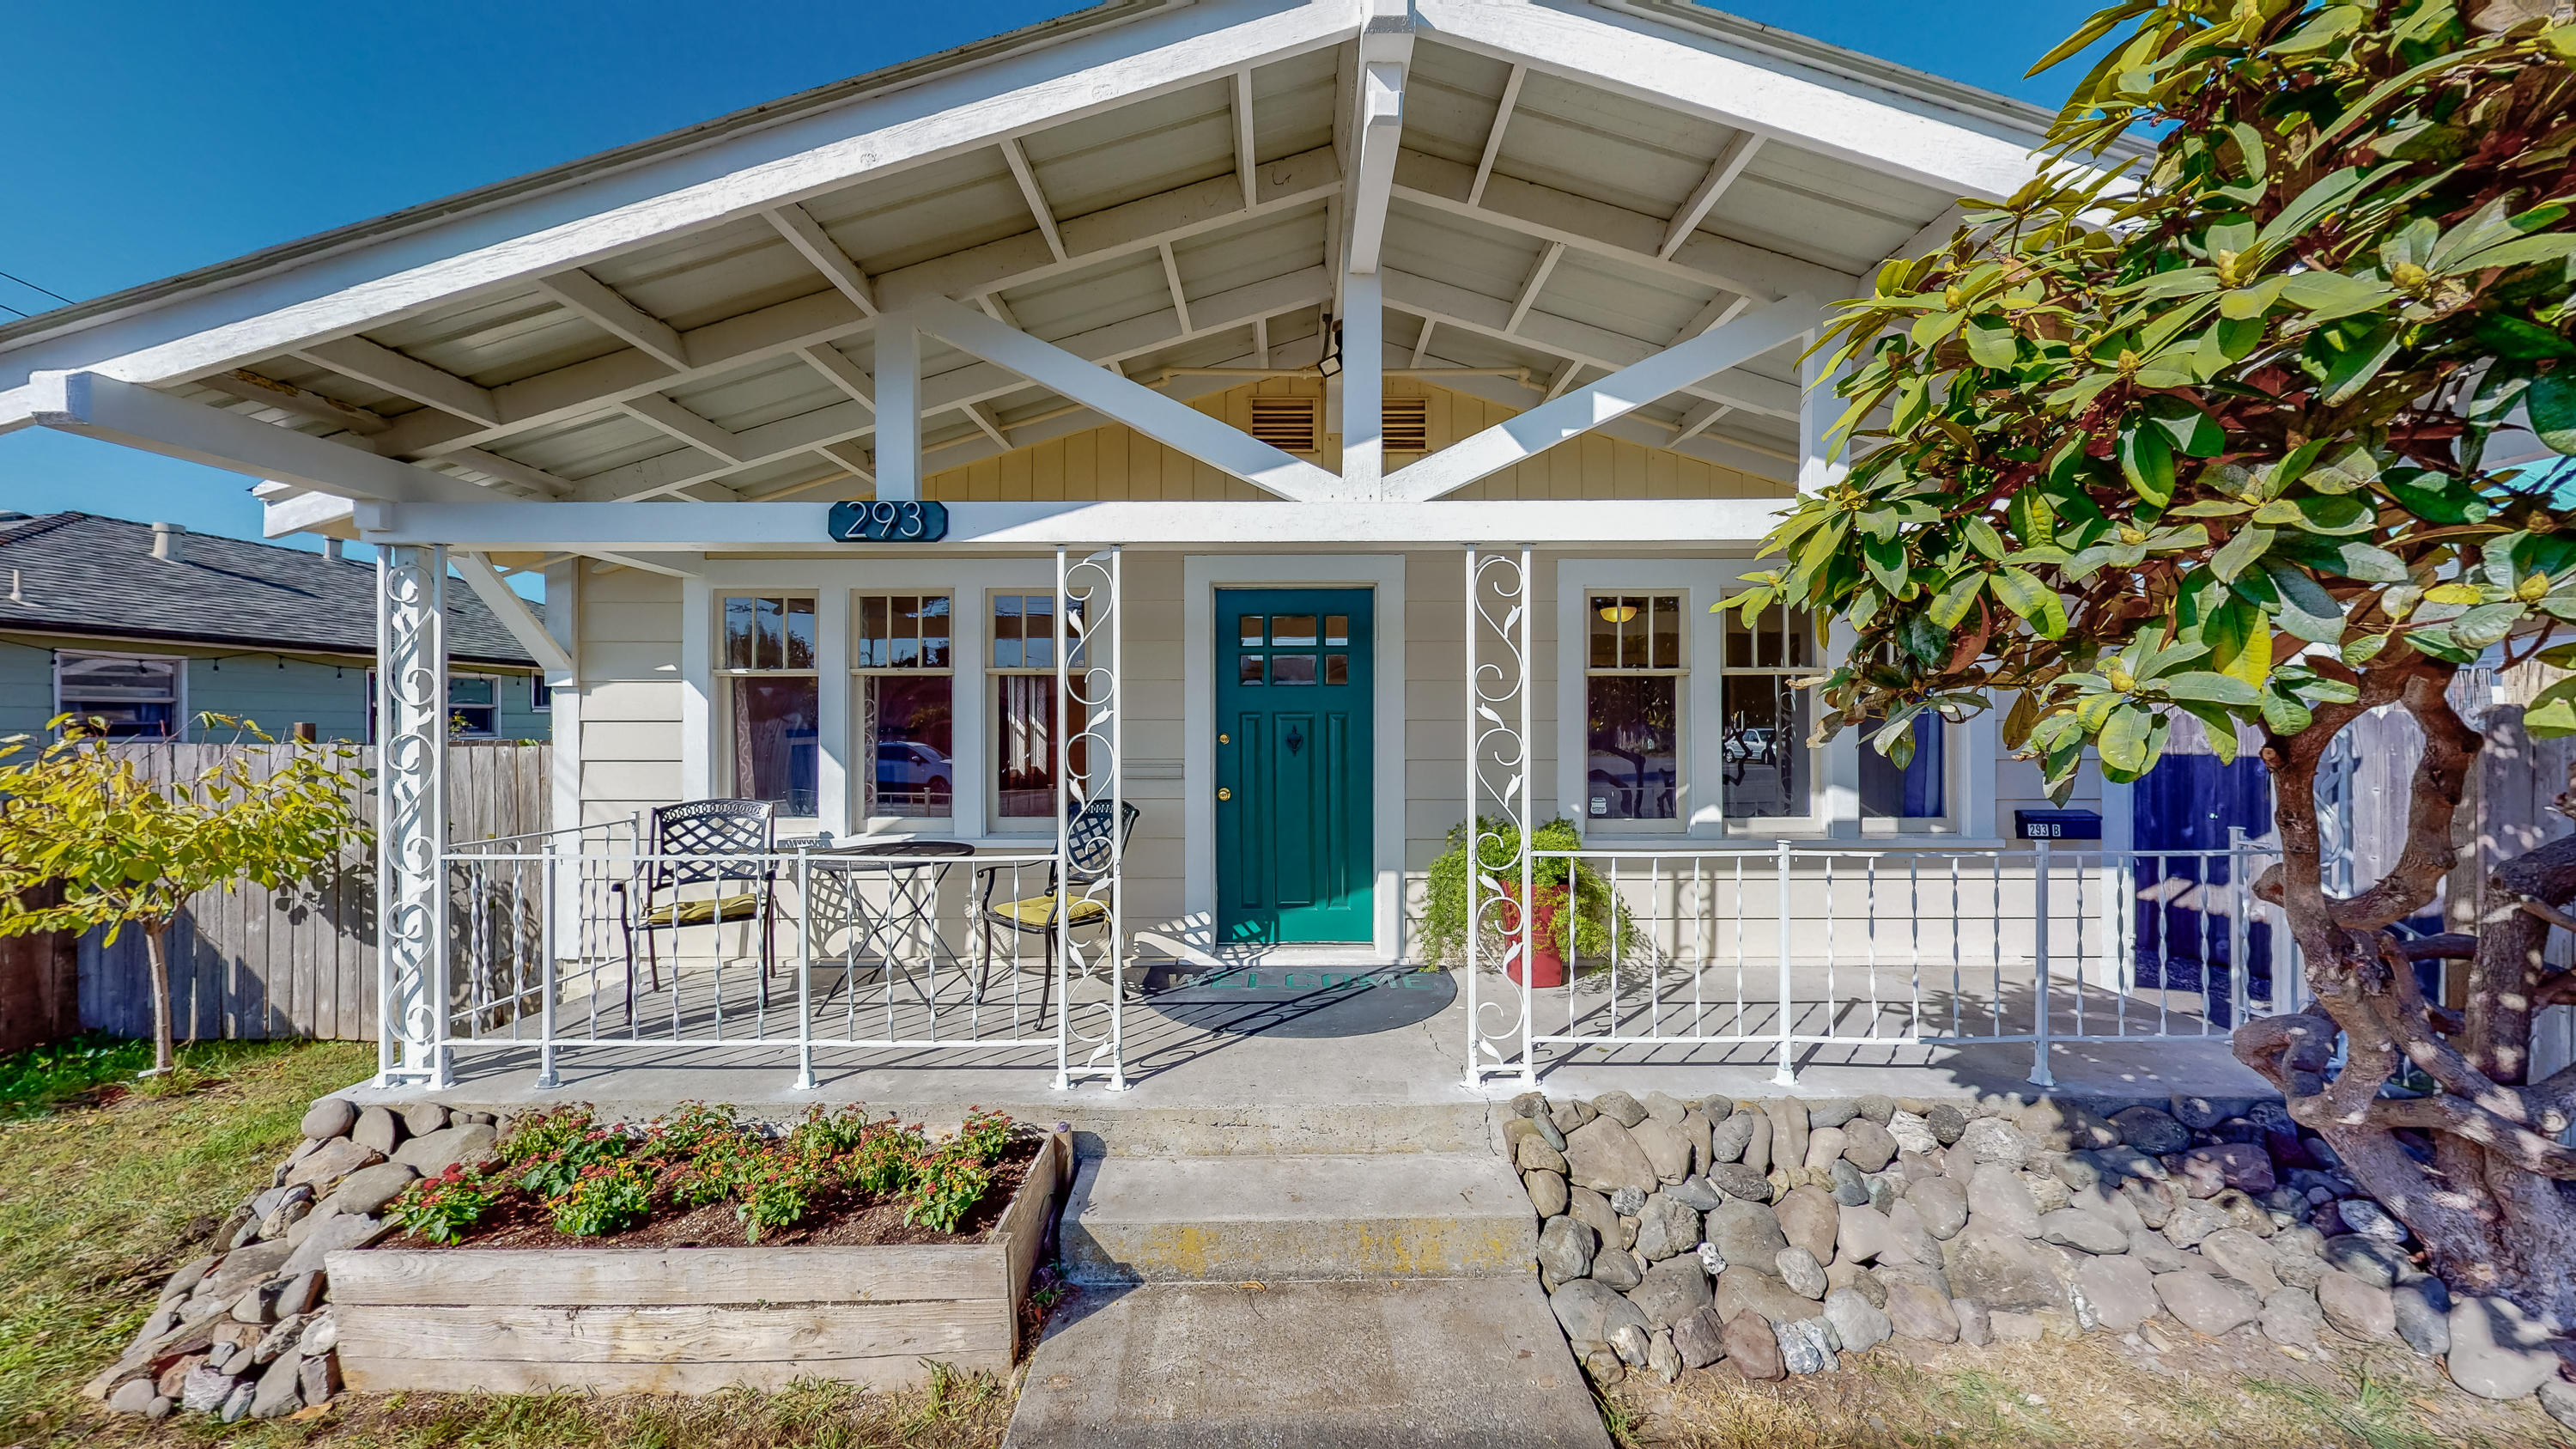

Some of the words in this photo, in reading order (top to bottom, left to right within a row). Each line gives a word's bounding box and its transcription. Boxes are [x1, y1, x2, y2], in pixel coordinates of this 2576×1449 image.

[845, 501, 922, 538] 293
[2029, 825, 2048, 836] 293
[2053, 825, 2060, 836] B
[1168, 972, 1435, 989] WELCOME
